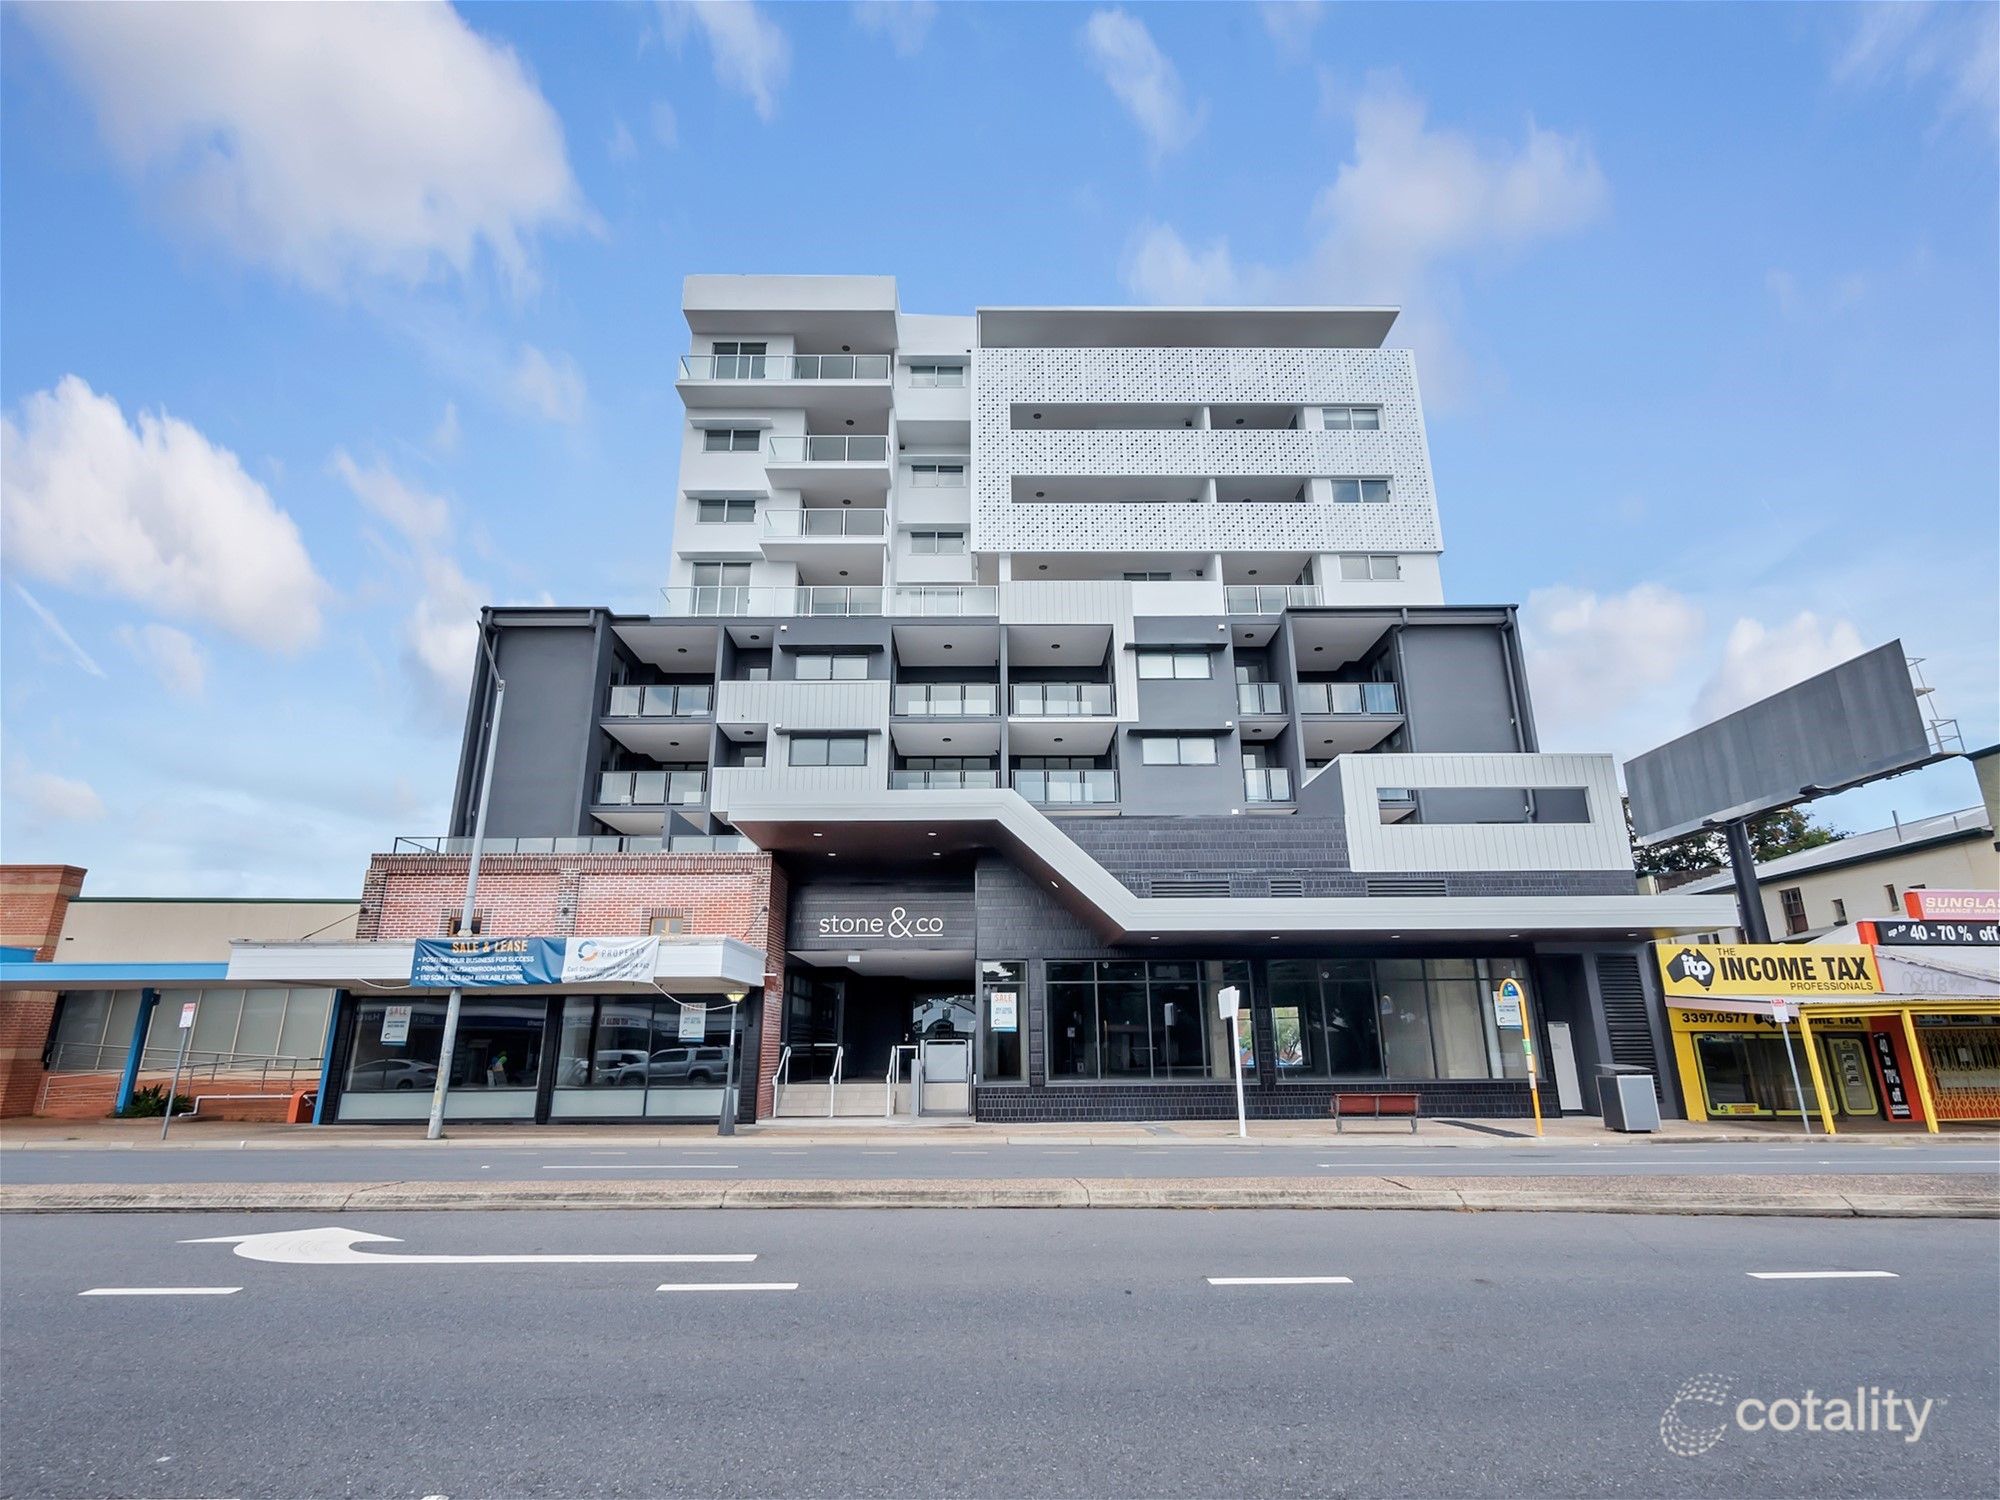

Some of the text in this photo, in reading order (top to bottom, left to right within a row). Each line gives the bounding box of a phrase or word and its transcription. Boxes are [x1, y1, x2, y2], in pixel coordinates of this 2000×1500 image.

[1888, 928, 1898, 937] up
[1979, 926, 1999, 941] off
[452, 940, 528, 953] SALE & LEASE
[1716, 947, 1736, 956] THE
[1681, 955, 1711, 980] itp
[1718, 957, 1870, 981] INCOME TAX
[1790, 981, 1874, 991] PROFESSIONALS
[388, 1007, 408, 1016] SALE
[1682, 1012, 1748, 1024] 3397.0577
